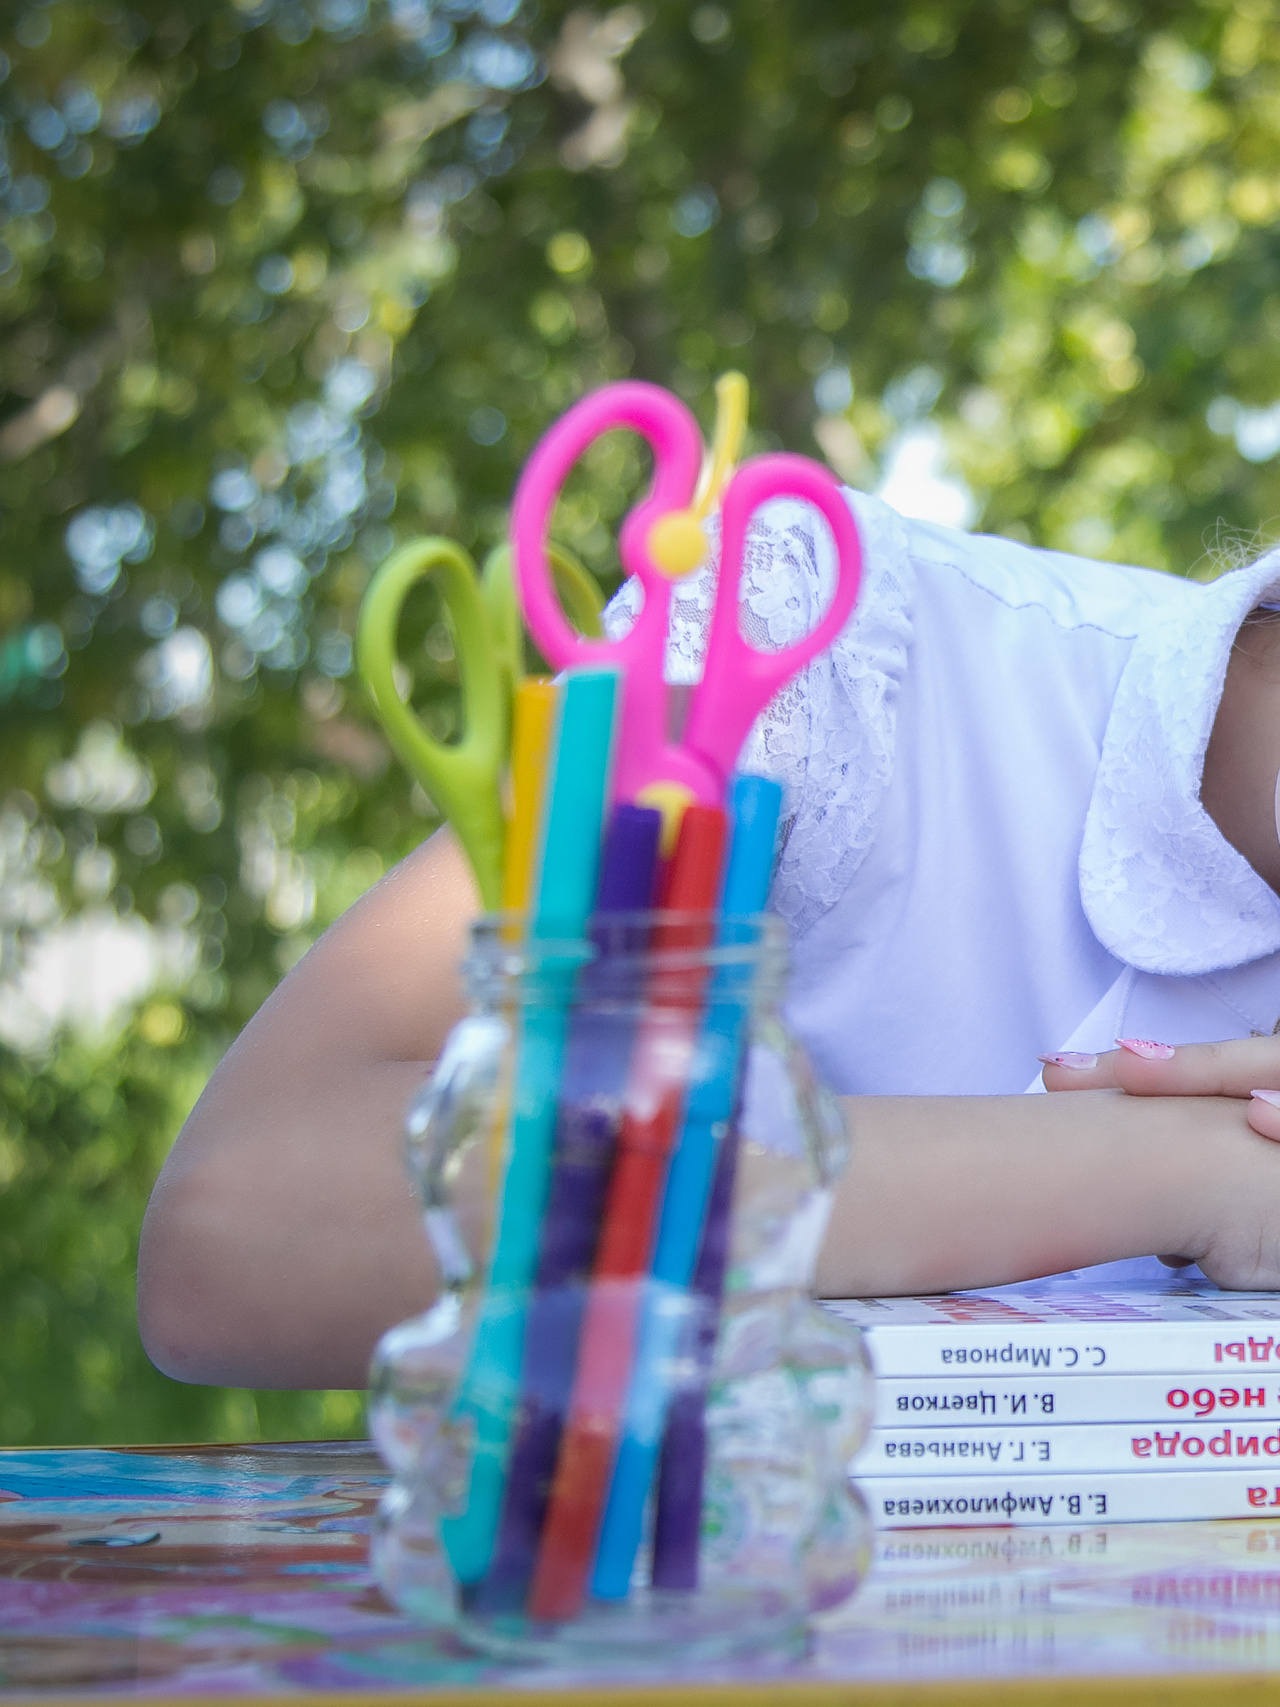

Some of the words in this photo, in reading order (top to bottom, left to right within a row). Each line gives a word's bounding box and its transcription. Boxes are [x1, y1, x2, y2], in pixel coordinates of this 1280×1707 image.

[941, 1342, 1051, 1368] Мирнова
[896, 1390, 996, 1416] Цветков
[1166, 1386, 1266, 1417] небо
[884, 1441, 1002, 1461] Ананьева
[883, 1491, 1054, 1518] Амфилохиева
